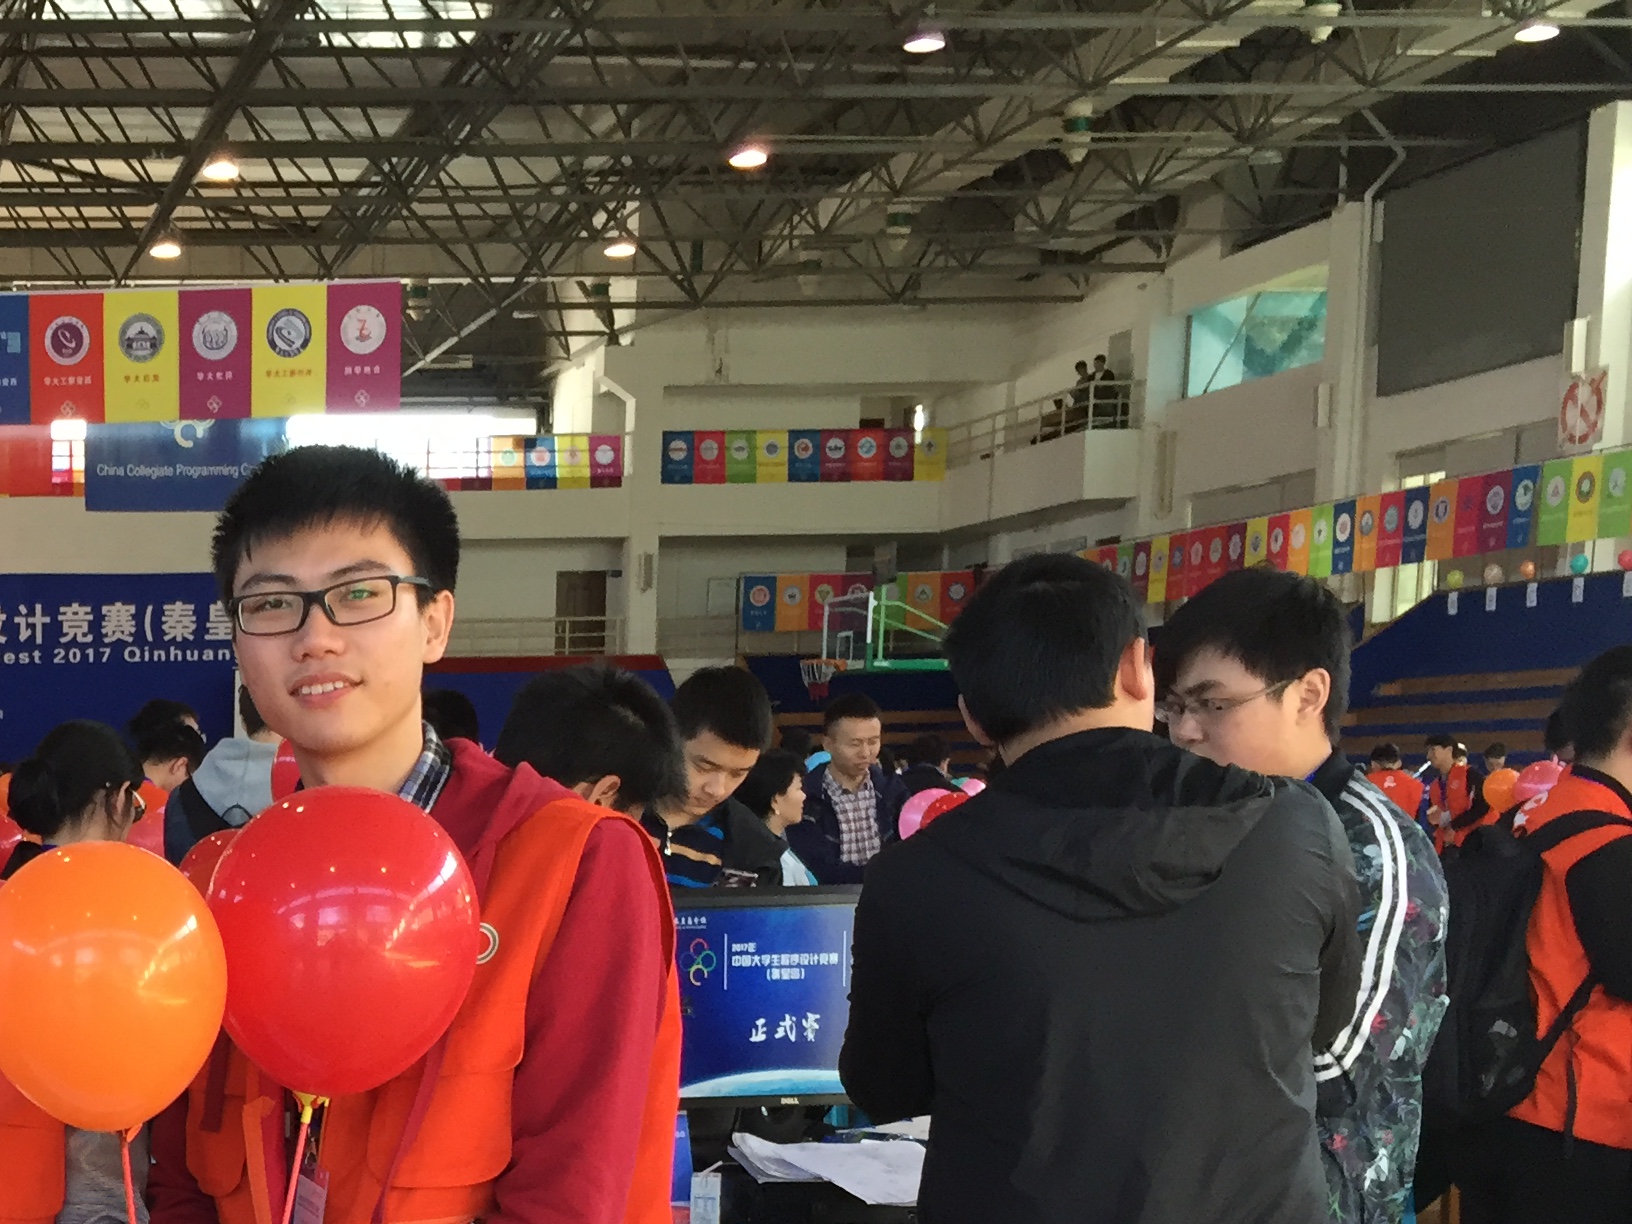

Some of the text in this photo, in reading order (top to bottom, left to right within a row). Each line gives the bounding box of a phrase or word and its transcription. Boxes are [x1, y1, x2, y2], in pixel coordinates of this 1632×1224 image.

[96, 463, 125, 476] China
[126, 463, 173, 479] Collegiate
[175, 463, 239, 479] Programming
[53, 648, 111, 664] 2017
[748, 1011, 821, 1043] 正式赛
